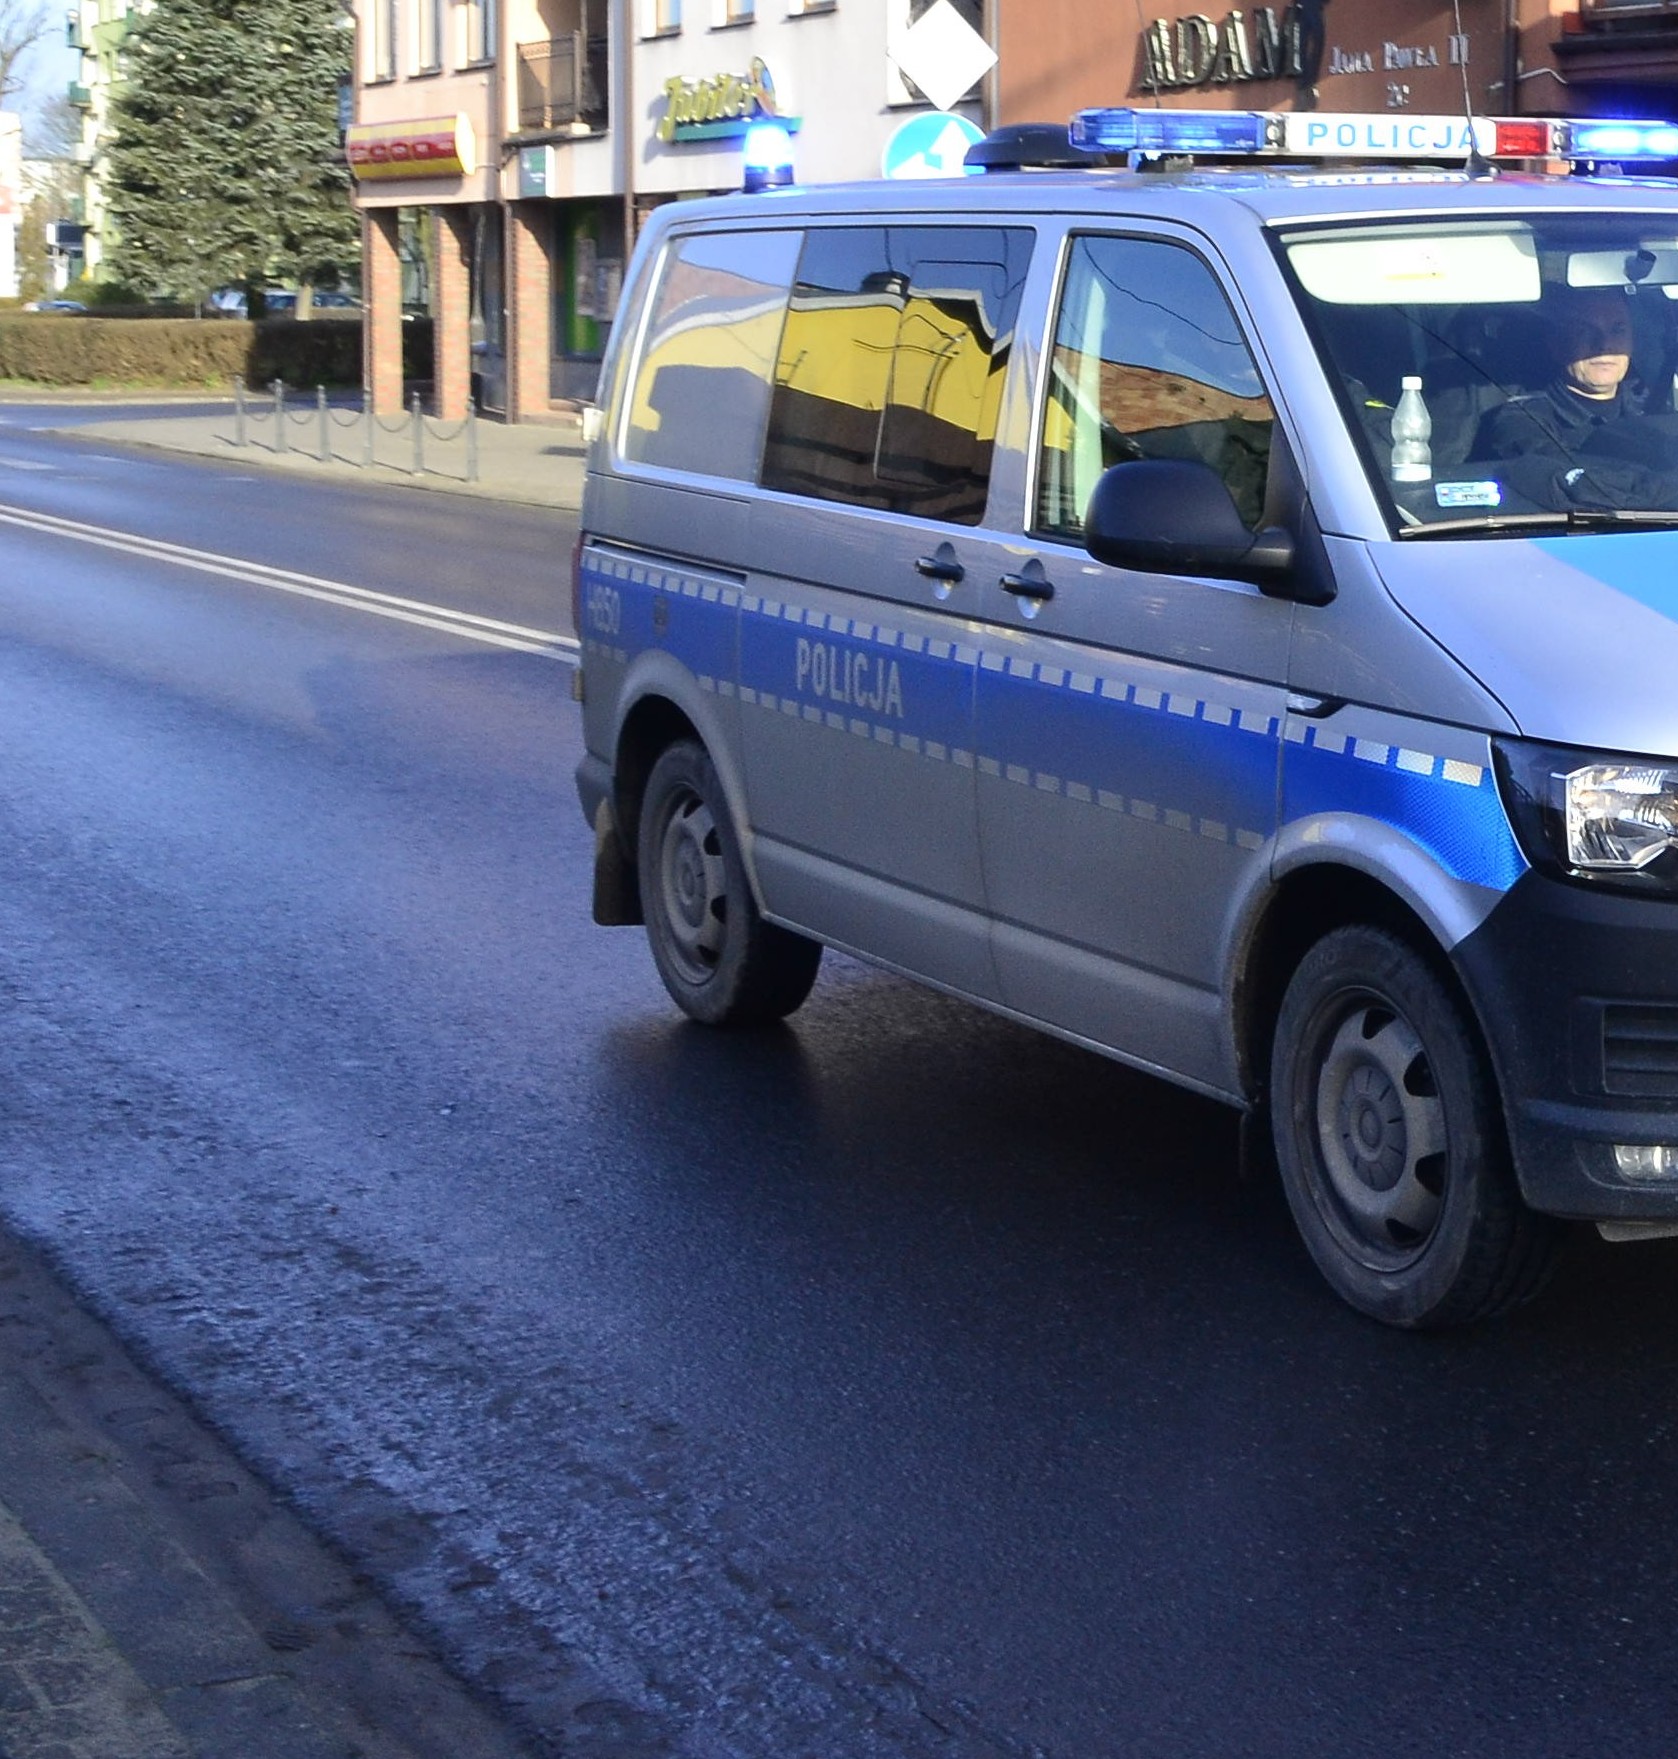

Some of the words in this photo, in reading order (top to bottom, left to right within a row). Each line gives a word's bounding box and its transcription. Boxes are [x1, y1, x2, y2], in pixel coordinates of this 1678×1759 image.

[1141, 5, 1303, 88] ADAM
[1307, 122, 1480, 150] POLICJA
[796, 637, 904, 719] POLICJA
